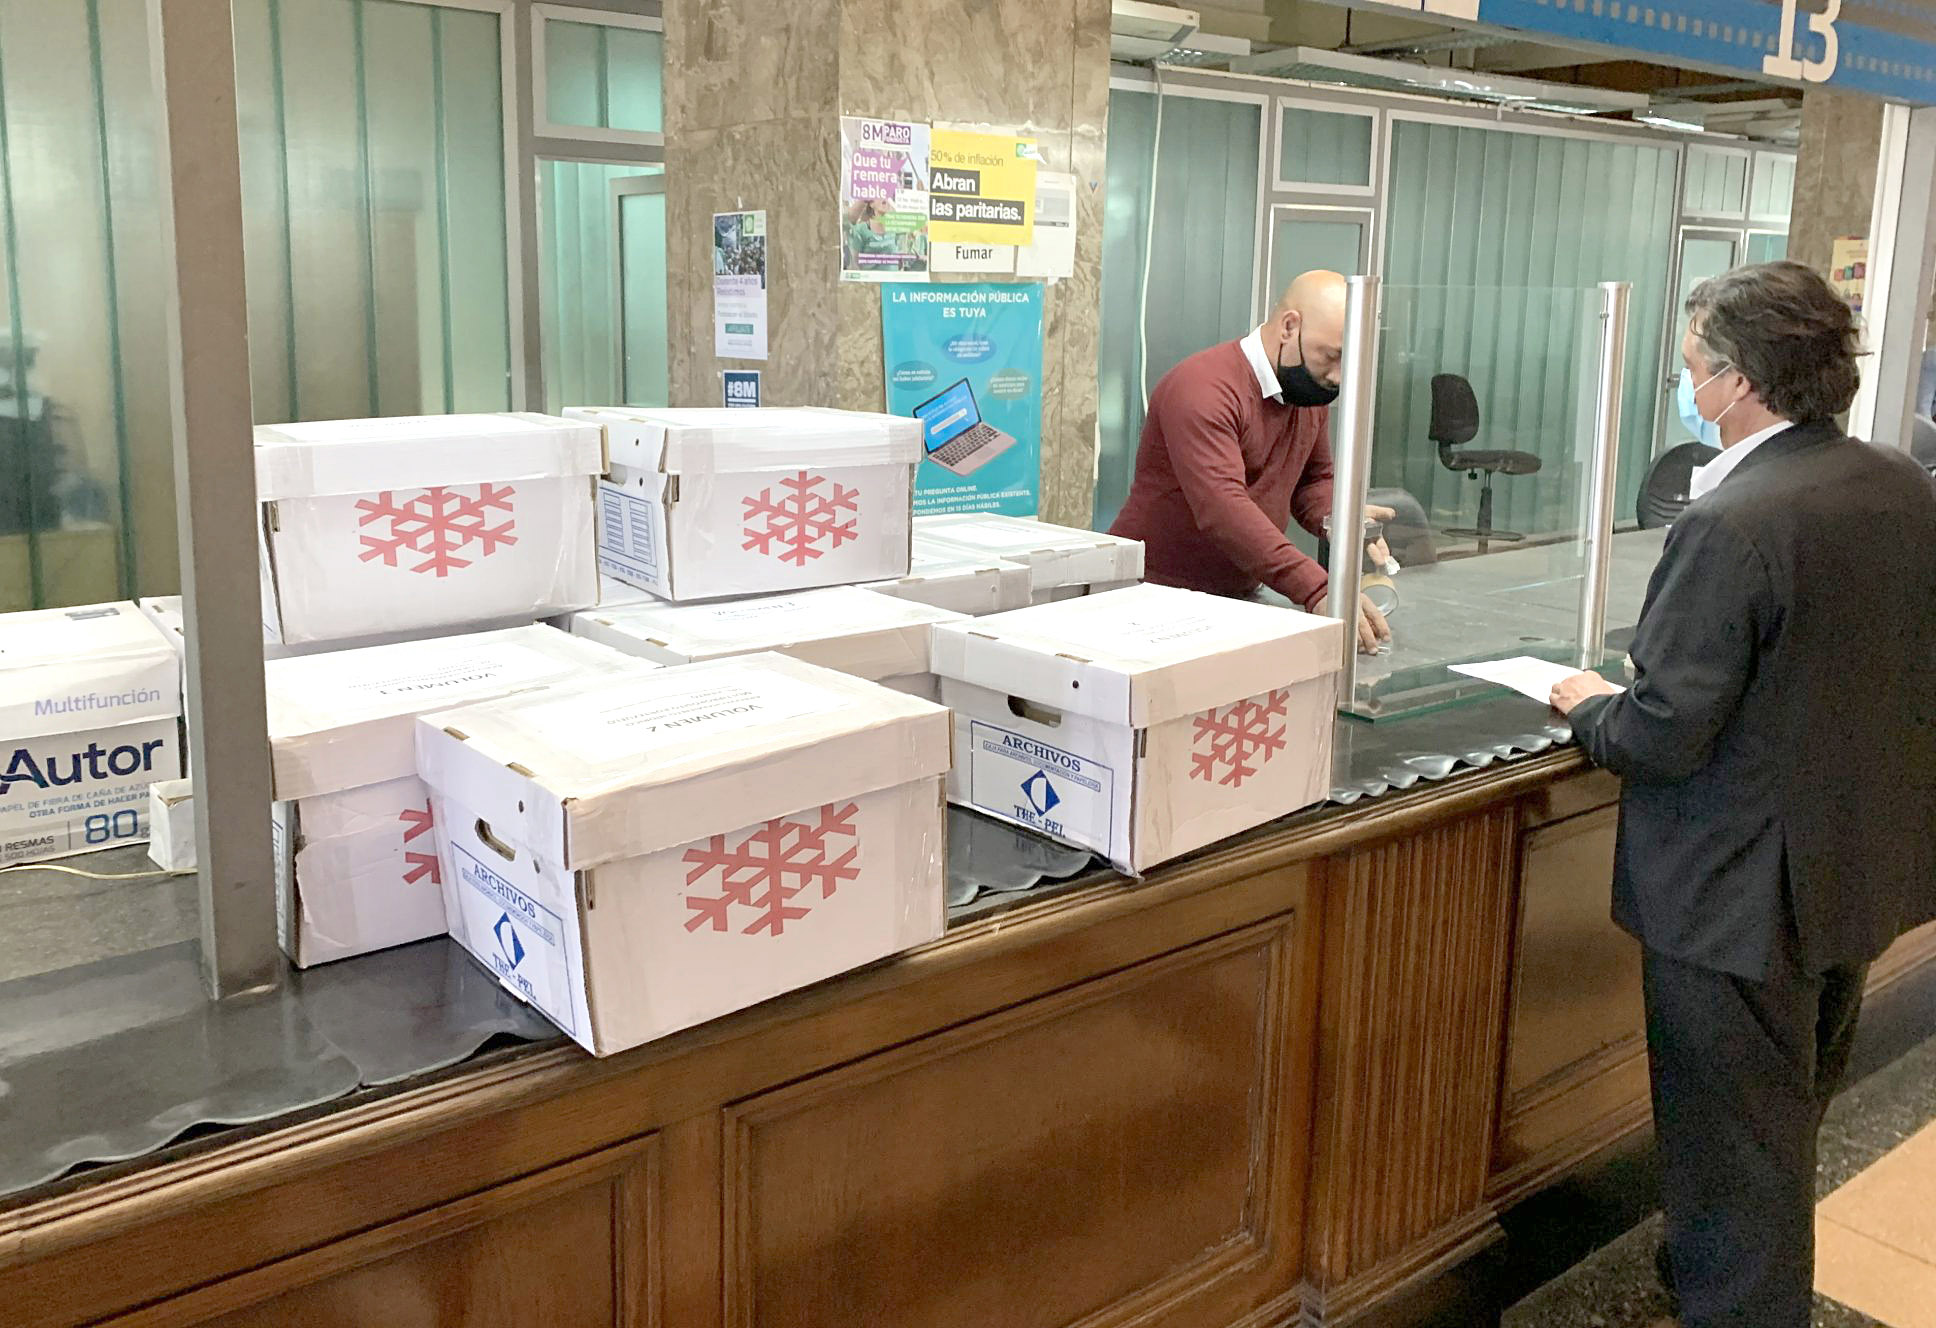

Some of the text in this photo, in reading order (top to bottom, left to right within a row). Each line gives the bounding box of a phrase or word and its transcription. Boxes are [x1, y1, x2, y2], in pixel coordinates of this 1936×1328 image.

[1763, 0, 1841, 83] 13
[884, 126, 910, 139] PARO
[853, 153, 891, 169] Que tu
[954, 152, 966, 164] de
[967, 153, 1004, 167] inflación
[853, 169, 897, 184] remera
[932, 171, 976, 192] Abran
[853, 184, 887, 199] hable
[931, 199, 1021, 222] las paritarias.
[955, 245, 993, 261] Fumar
[892, 290, 1030, 304] LA INFORMACIÓN PÚBLICA
[943, 307, 986, 318] ES TUYA
[727, 381, 757, 398] #8M
[923, 488, 955, 496] PREGUNTA
[927, 497, 936, 505] LA
[912, 507, 946, 516] PONDEMOS
[34, 687, 161, 716] Multifunción
[663, 704, 764, 729] VOLUMEN
[1002, 734, 1081, 772] ARCHIVOS
[0, 739, 163, 795] Autor
[28, 801, 40, 809] DE
[29, 791, 150, 818] OTRA FORMA DE HACER PA
[1014, 804, 1037, 823] THE
[85, 809, 138, 844] 80
[5, 835, 54, 851] RESMAS
[474, 863, 537, 919] ARCHIVOS
